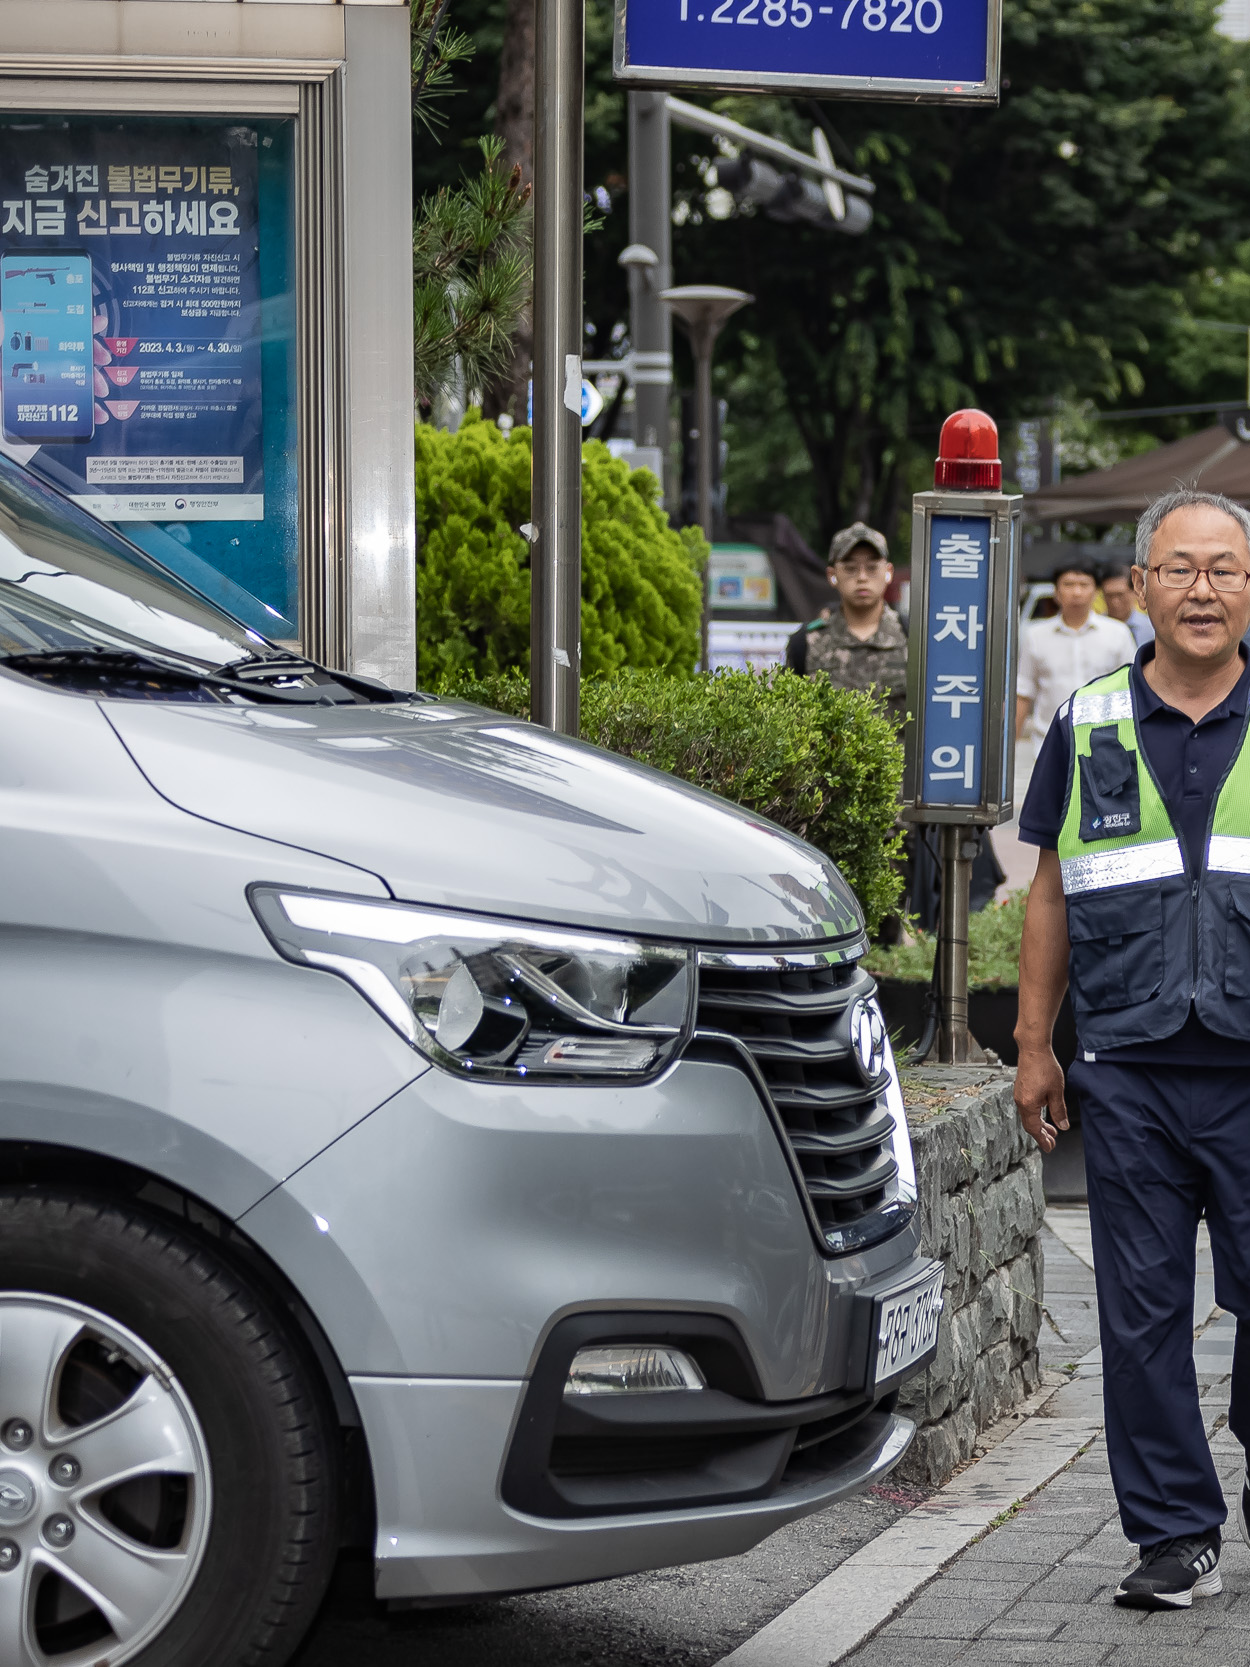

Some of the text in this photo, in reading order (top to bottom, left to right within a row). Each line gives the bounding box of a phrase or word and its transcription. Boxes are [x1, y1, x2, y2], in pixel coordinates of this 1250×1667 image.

[24, 164, 241, 196] 숨겨진 불법무기류,
[1, 199, 241, 236] 지금 신고하세요
[166, 253, 240, 261] 불법무기류 자진신고 시
[110, 263, 241, 273] 형사책임 및 행정책임이 면제됩니다.
[145, 274, 241, 284] 불법무기 소지자를 발견하면
[132, 285, 241, 295] 112로 신고하여 주시기 바랍니다.
[122, 300, 241, 308] 신고자에게는 검거 시 최대 500만원까지
[65, 304, 85, 315] 도검
[181, 309, 241, 317] 보상금을 지급합니다.
[58, 341, 85, 352] 화약류
[140, 371, 184, 379] 불법무기류 일체
[17, 412, 48, 422] 자진신고
[49, 404, 79, 422] 112
[929, 533, 984, 789] 출차주의
[883, 1303, 910, 1371] 78구
